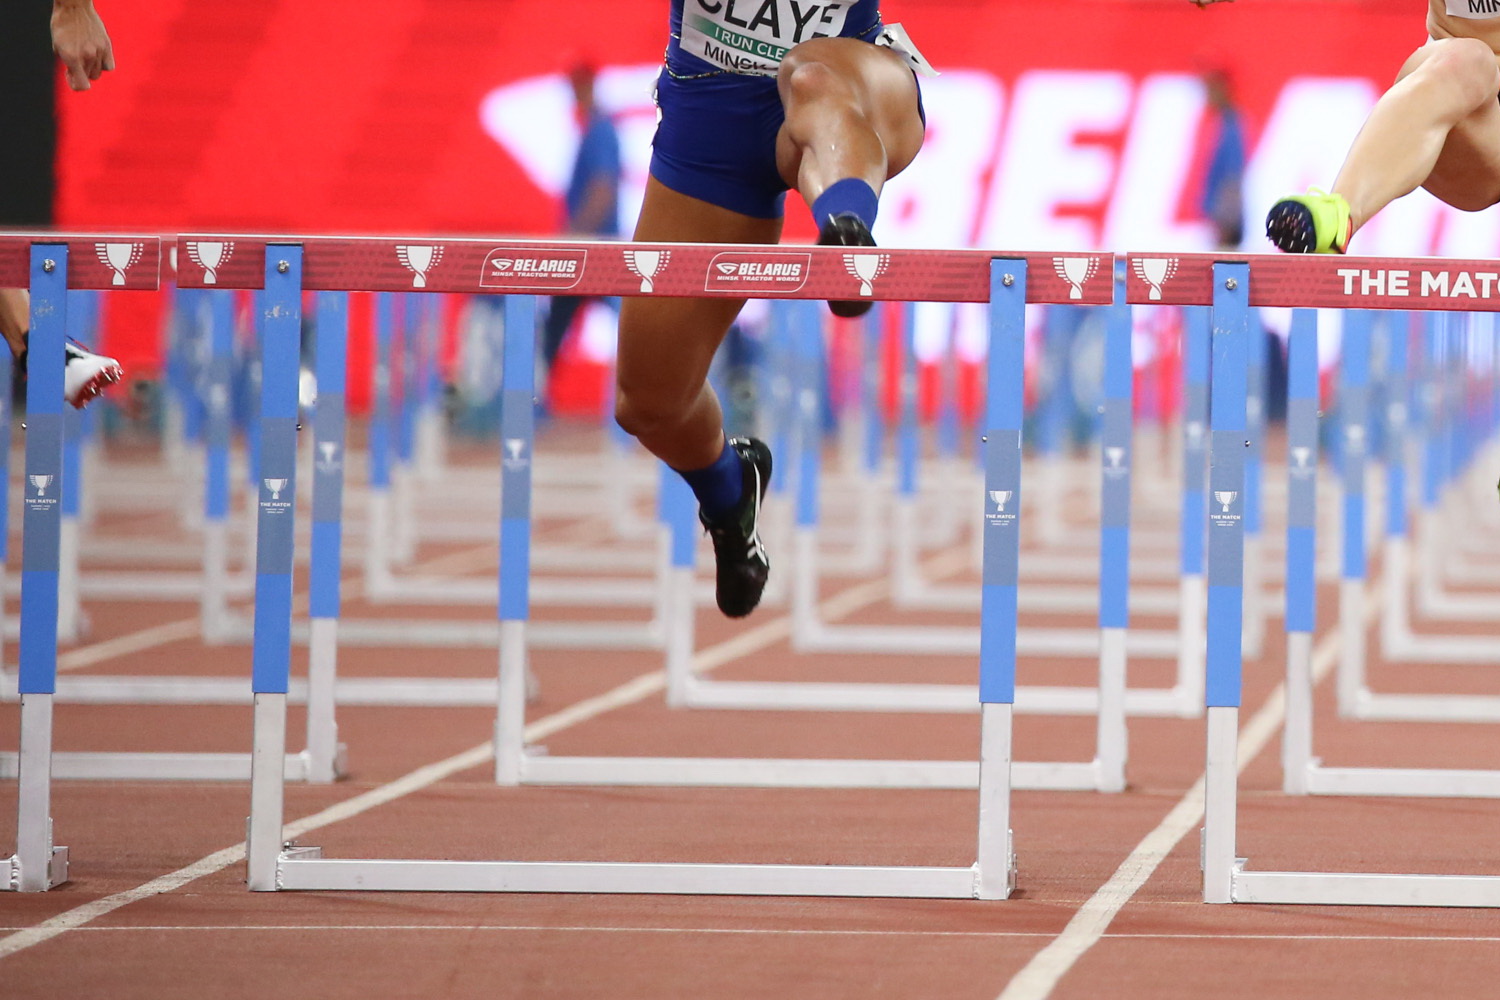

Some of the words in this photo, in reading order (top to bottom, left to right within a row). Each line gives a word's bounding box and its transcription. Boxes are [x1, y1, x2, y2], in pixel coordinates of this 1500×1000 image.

[715, 27, 720, 38] I
[721, 30, 753, 51] RUN
[757, 43, 785, 59] CLE
[513, 259, 577, 272] BELARUS
[738, 263, 801, 276] BELARUS
[1337, 268, 1410, 296] THE
